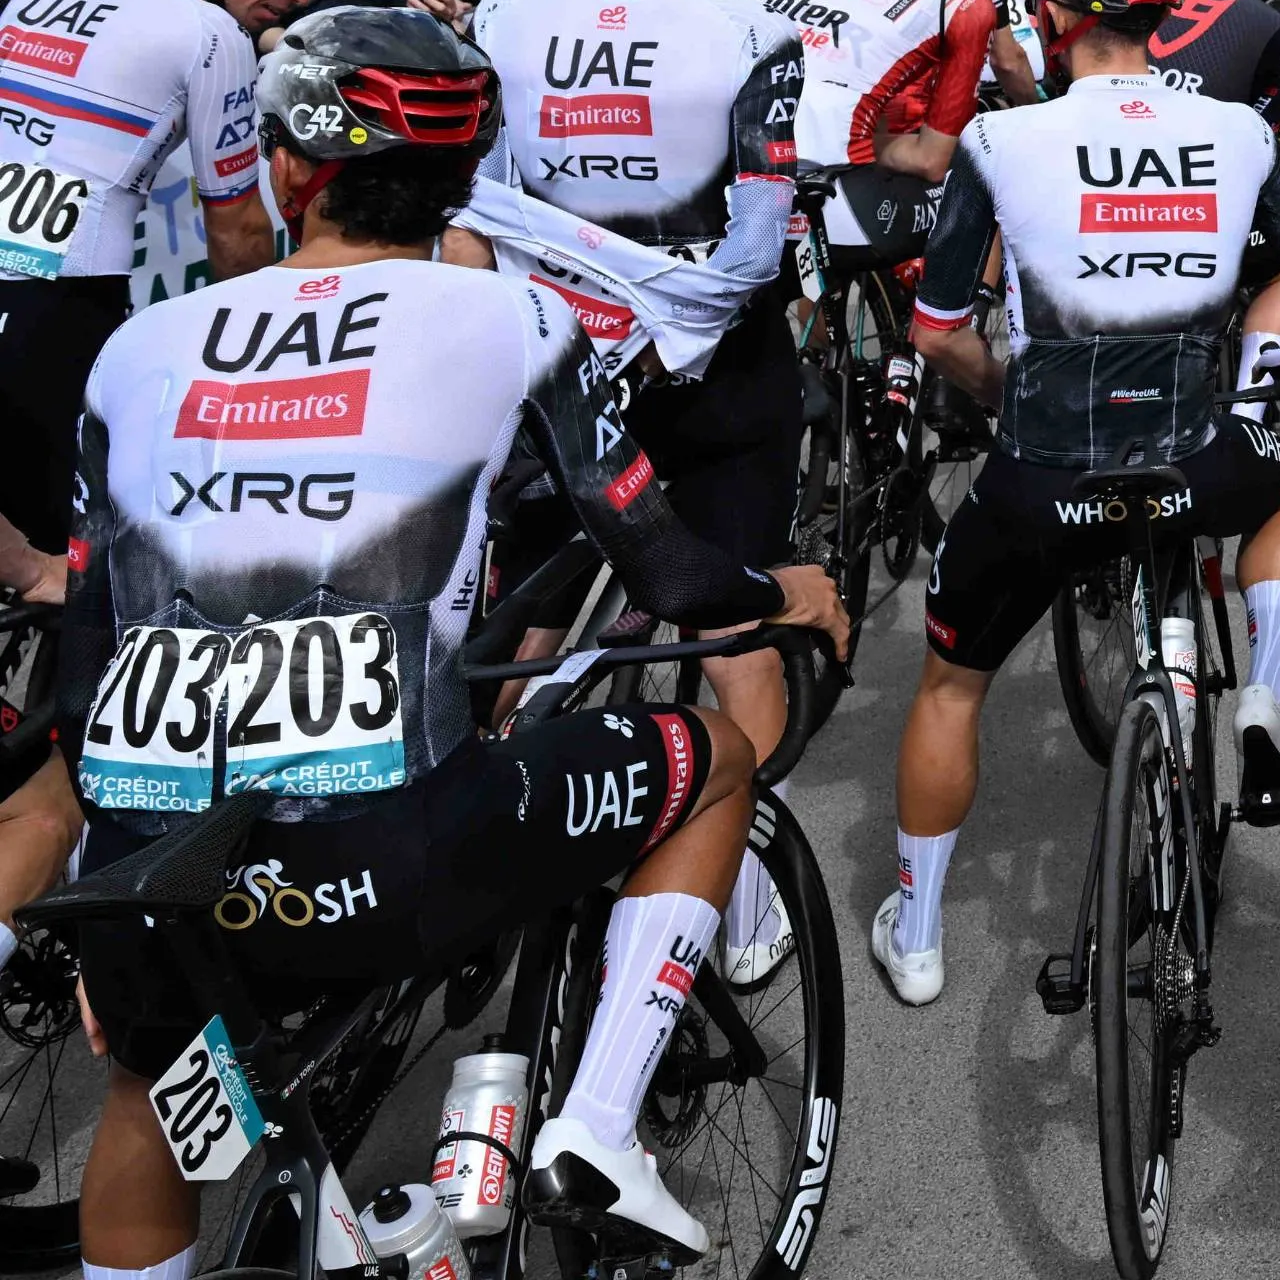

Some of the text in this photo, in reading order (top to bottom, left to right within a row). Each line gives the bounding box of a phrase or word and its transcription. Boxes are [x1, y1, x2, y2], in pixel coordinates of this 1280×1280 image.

[279, 63, 336, 80] MET
[544, 35, 659, 89] UAE
[290, 103, 344, 142] G42
[550, 104, 642, 127] Emirates
[538, 155, 659, 182] XRG
[1076, 142, 1218, 189] UAE
[1094, 201, 1207, 223] Emirates
[1076, 251, 1218, 279] XRG
[200, 292, 389, 372] UAE
[196, 391, 348, 426] Emirates
[1110, 388, 1162, 401] #WeAreUAE
[171, 470, 356, 522] XRG
[88, 613, 400, 753] 203 203
[101, 770, 404, 813] AGRICOLE AGRICOLE
[103, 760, 372, 796] CRÉDIT CRÉDIT
[565, 760, 649, 837] UAE
[153, 1049, 234, 1173] 203
